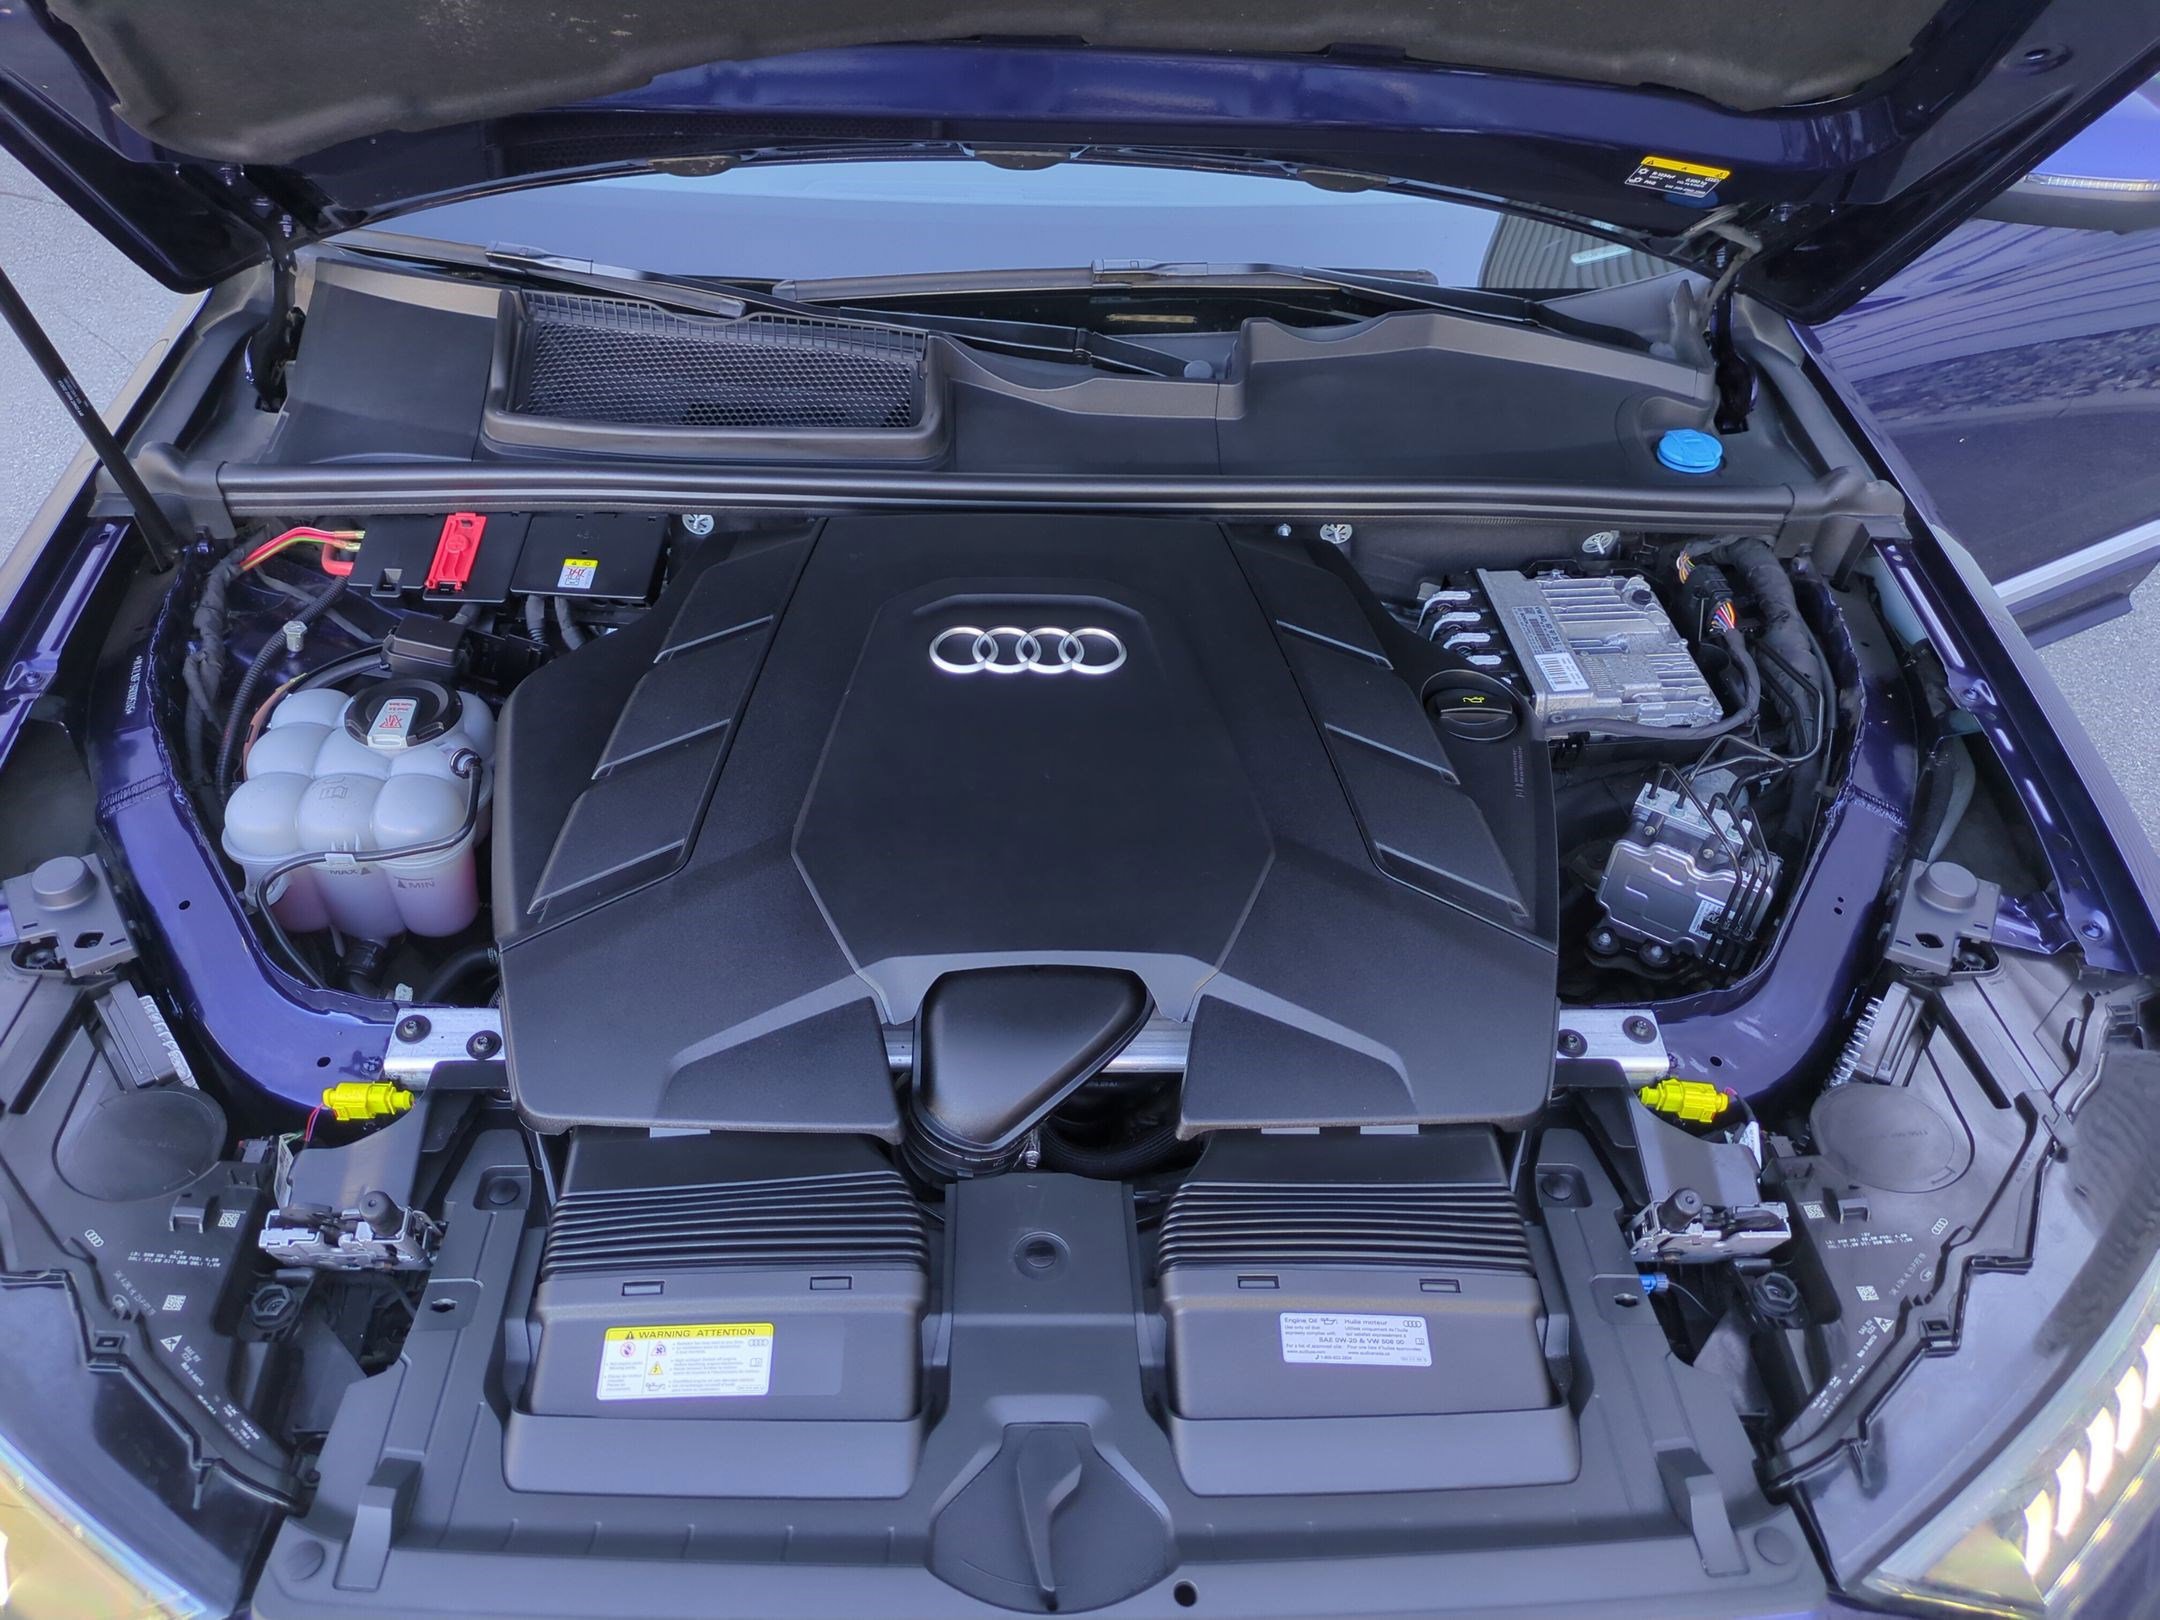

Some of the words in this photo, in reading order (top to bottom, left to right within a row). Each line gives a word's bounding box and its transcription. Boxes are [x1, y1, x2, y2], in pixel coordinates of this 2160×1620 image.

[408, 881, 436, 889] MIN
[638, 1329, 691, 1339] WARNING
[696, 1328, 756, 1337] ATTENTION
